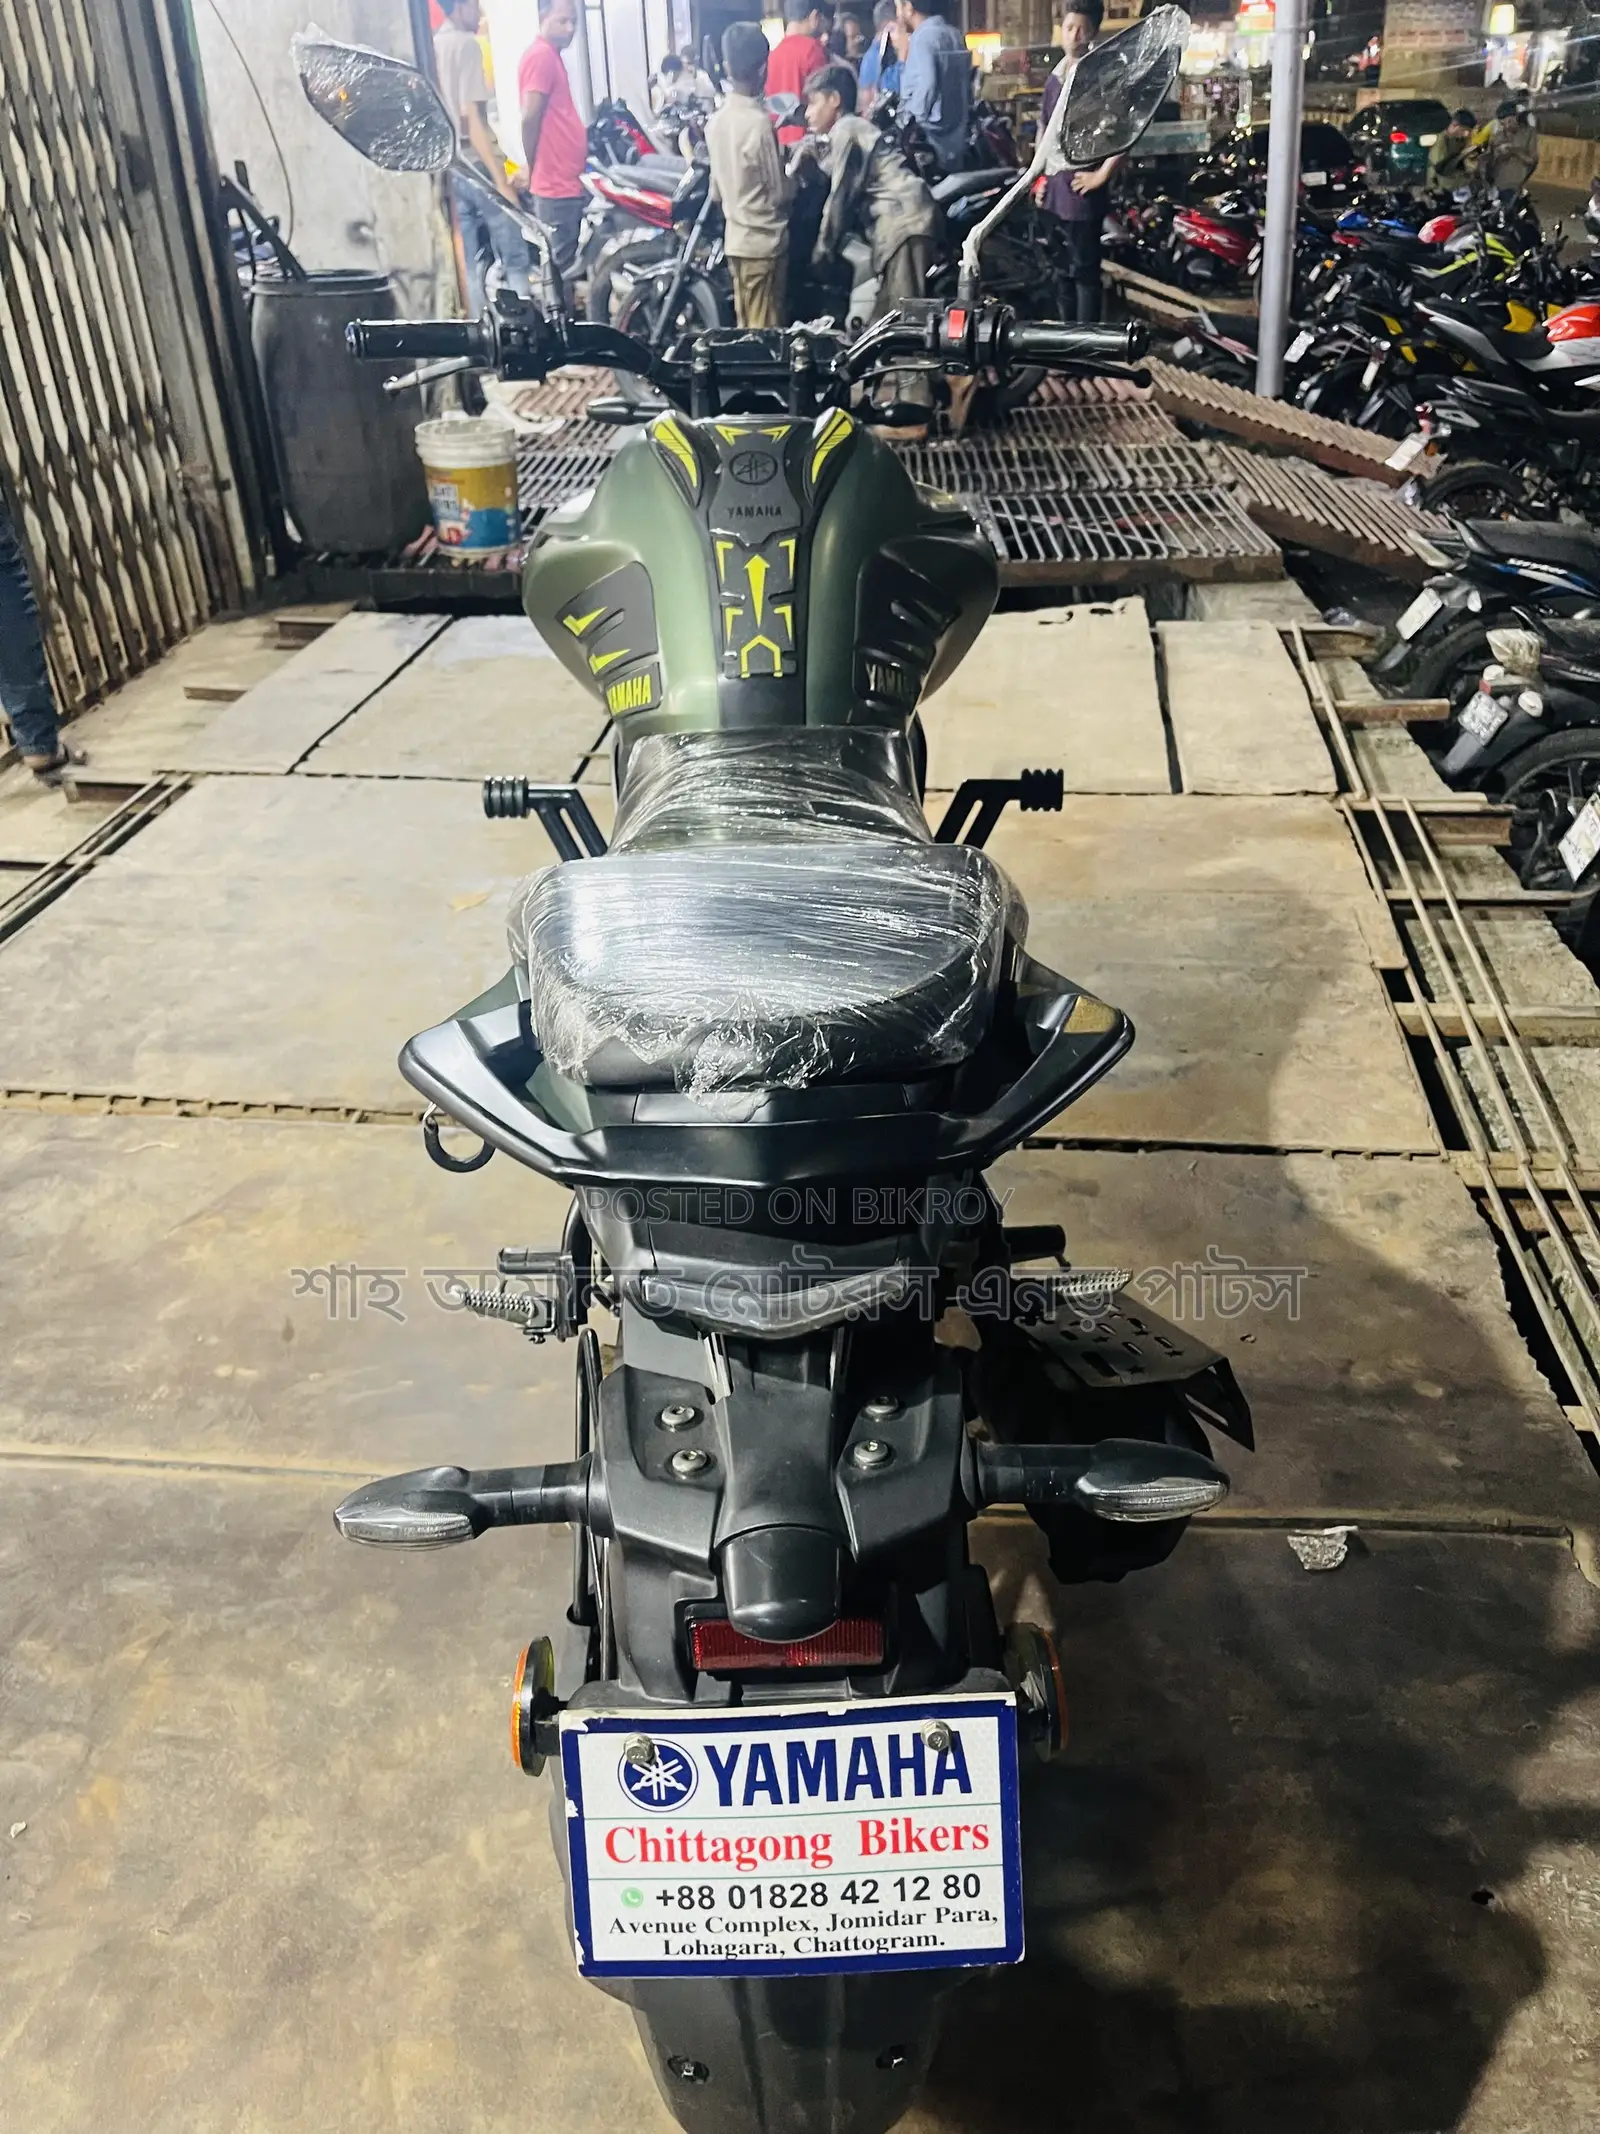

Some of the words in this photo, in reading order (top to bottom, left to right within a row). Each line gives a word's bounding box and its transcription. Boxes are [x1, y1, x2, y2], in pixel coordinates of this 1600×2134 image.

[727, 504, 782, 519] YAMAHA
[606, 673, 652, 716] YAMAHA
[703, 1731, 972, 1806] YAMAHA
[605, 1826, 833, 1872] Chittagong
[858, 1817, 989, 1856] Bikers
[656, 1884, 716, 1910] +88
[728, 1882, 828, 1909] 01828
[840, 1879, 880, 1905] 42
[893, 1876, 931, 1902] 12
[942, 1873, 981, 1900] 80
[609, 1917, 698, 1934] Avenue
[705, 1915, 819, 1937] Complex,
[826, 1910, 927, 1932] Jomidar
[935, 1906, 998, 1926] Para,
[663, 1939, 785, 1960] Lohagara,
[793, 1933, 946, 1955] Chattogram.
